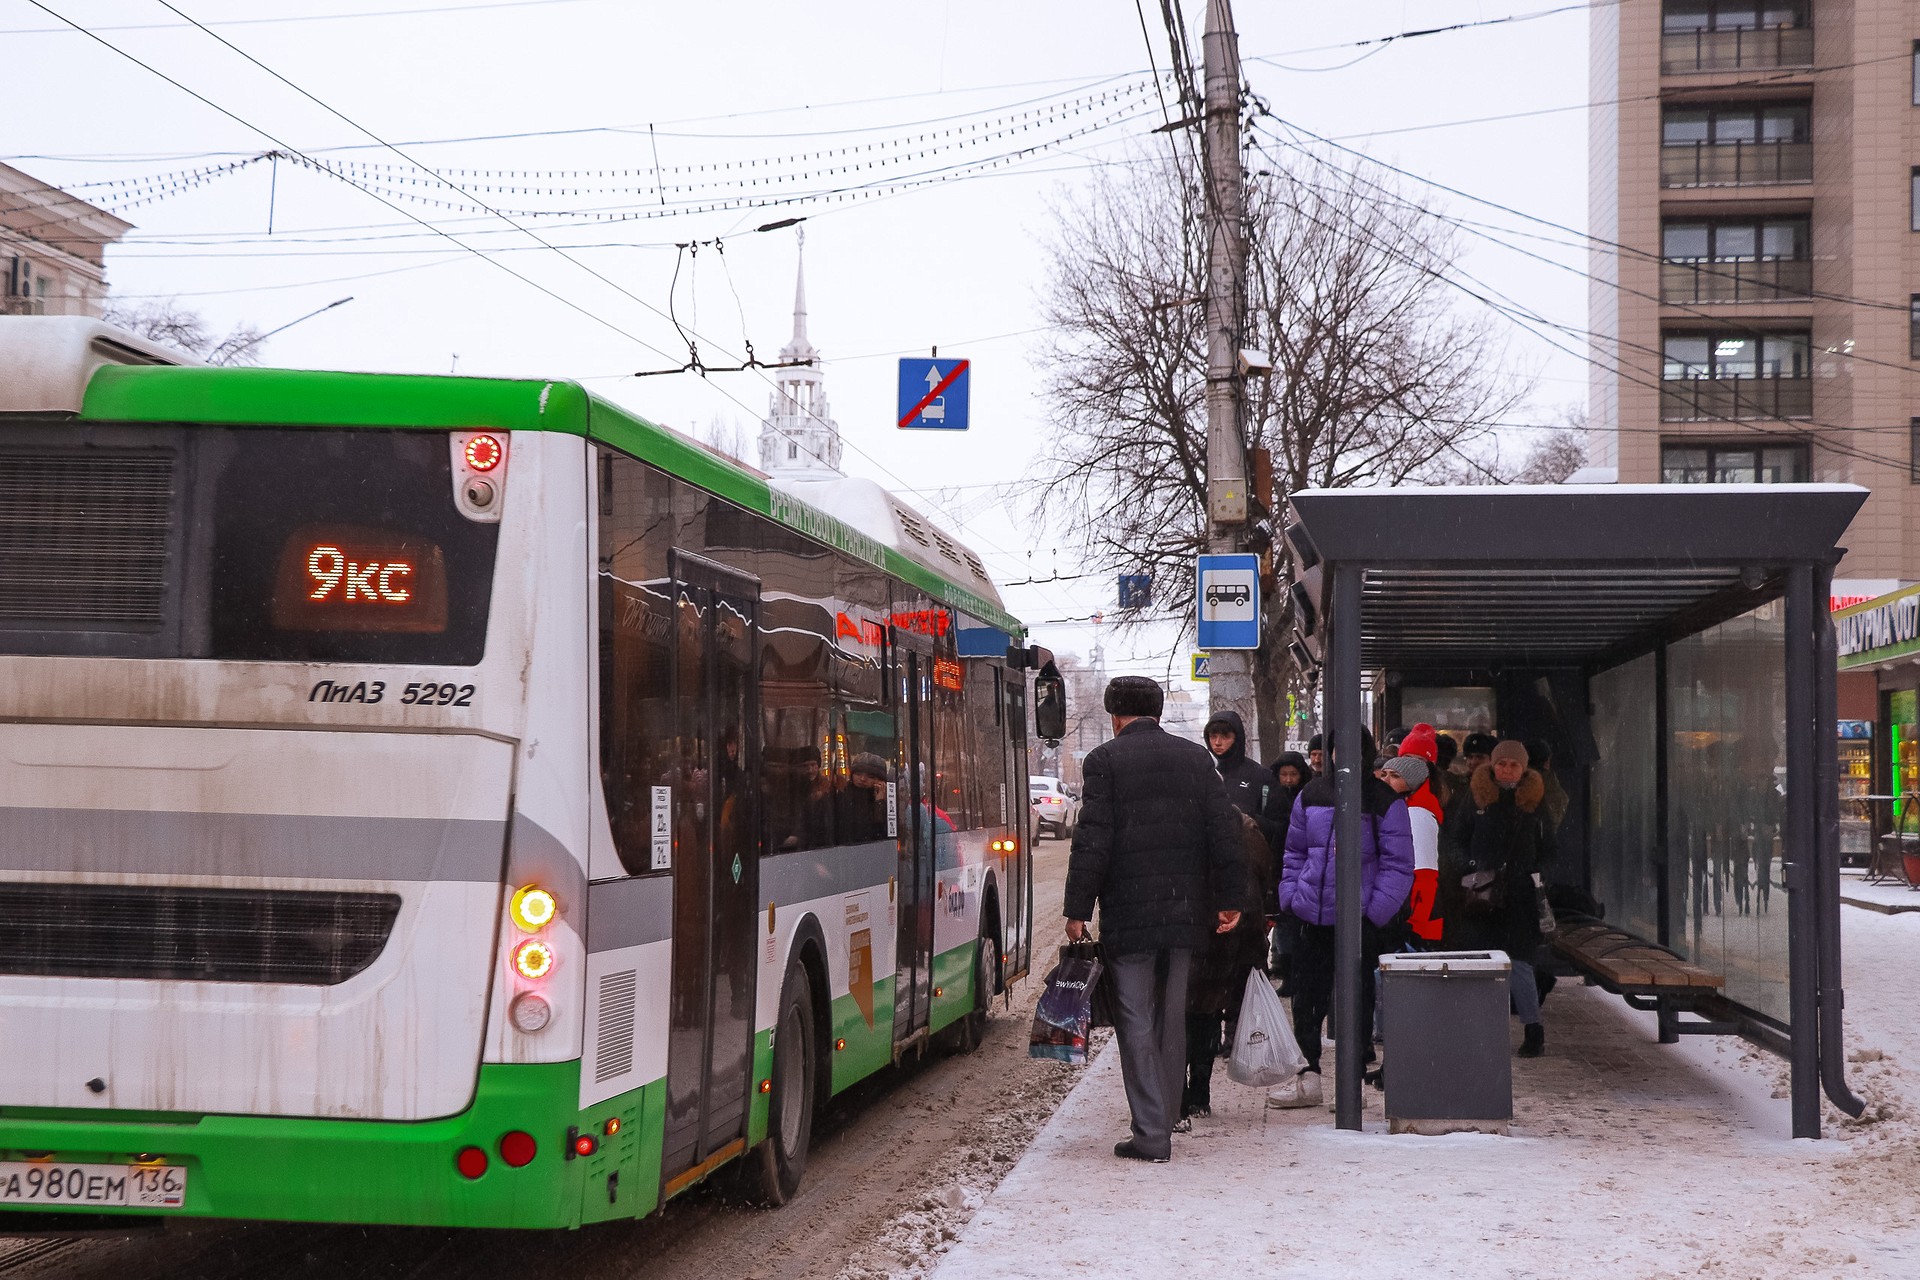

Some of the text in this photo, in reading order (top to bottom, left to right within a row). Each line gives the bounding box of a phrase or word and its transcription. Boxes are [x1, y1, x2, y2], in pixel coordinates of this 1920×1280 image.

[1836, 604, 1892, 656] ШАУРМА
[400, 682, 475, 706] 5292
[132, 1168, 175, 1193] 136
